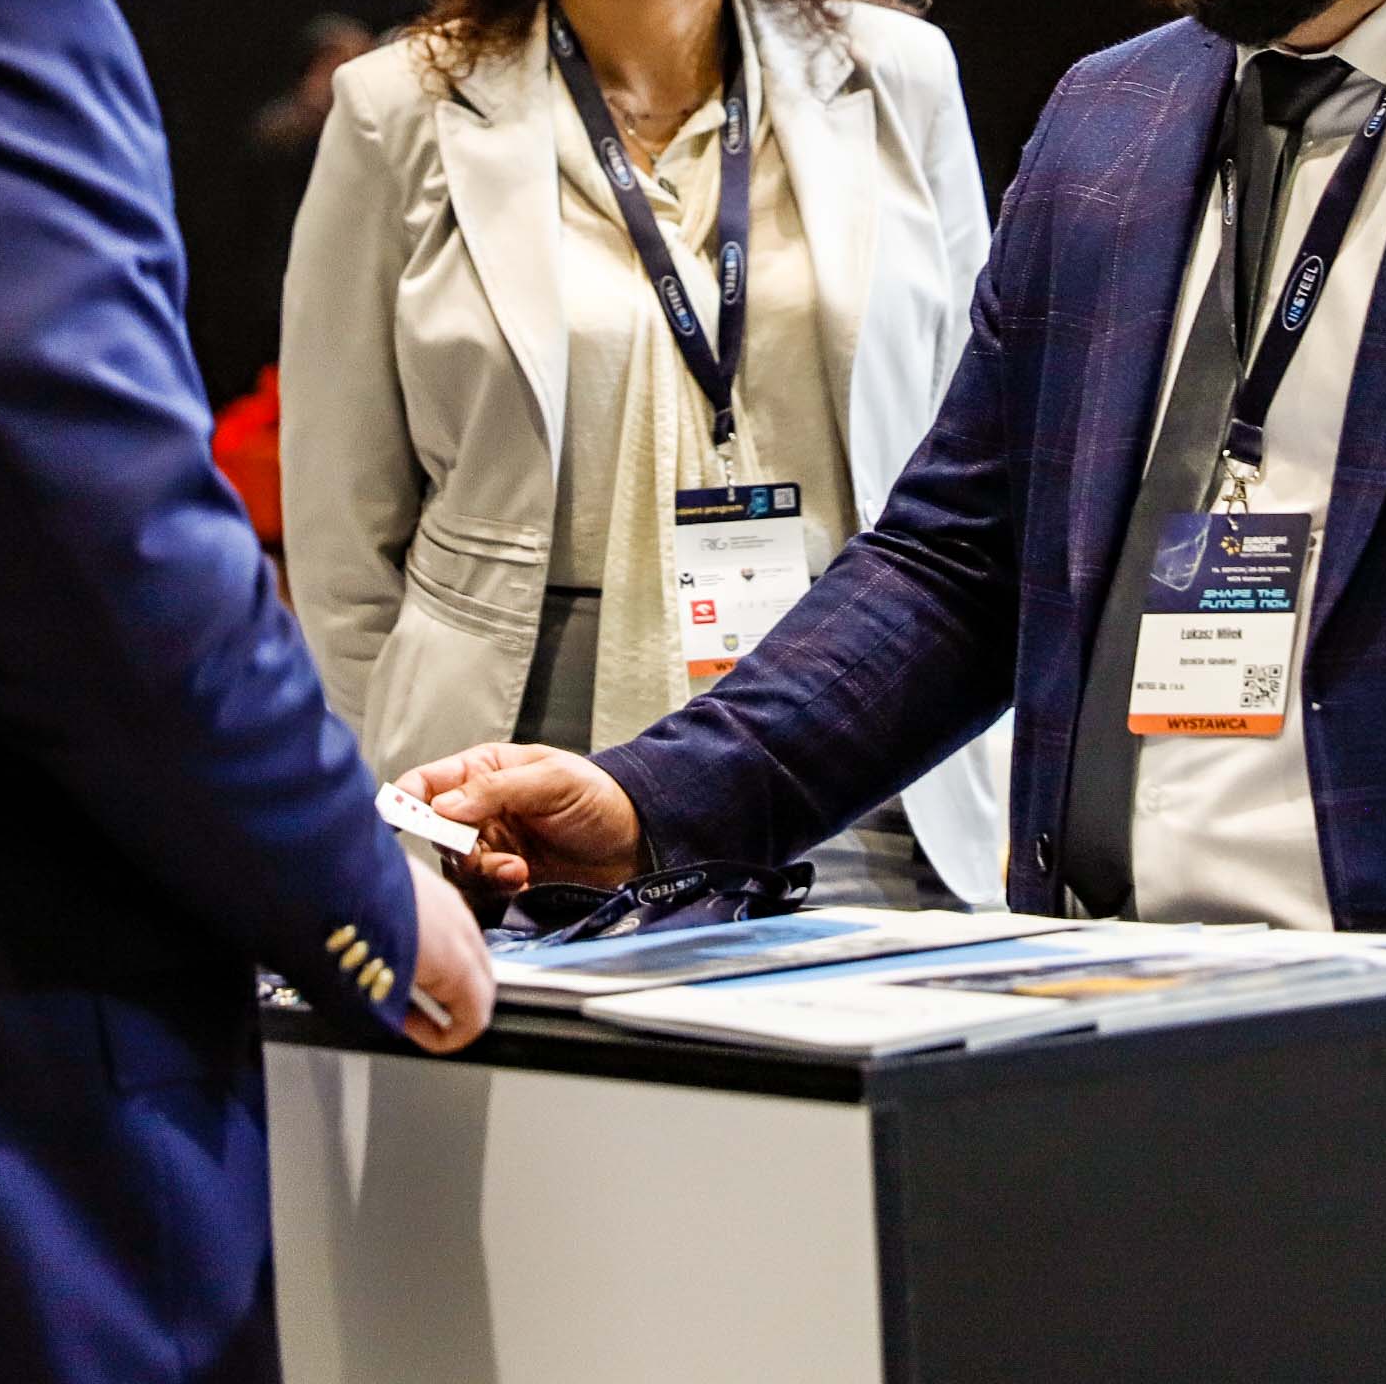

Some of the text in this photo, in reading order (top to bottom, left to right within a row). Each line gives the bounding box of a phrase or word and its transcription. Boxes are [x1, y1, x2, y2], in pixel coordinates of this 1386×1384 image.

[1203, 589, 1286, 599] SHAPE THE
[1199, 599, 1291, 609] FUTURE NOW
[1167, 718, 1248, 730] WYSTAWCA
